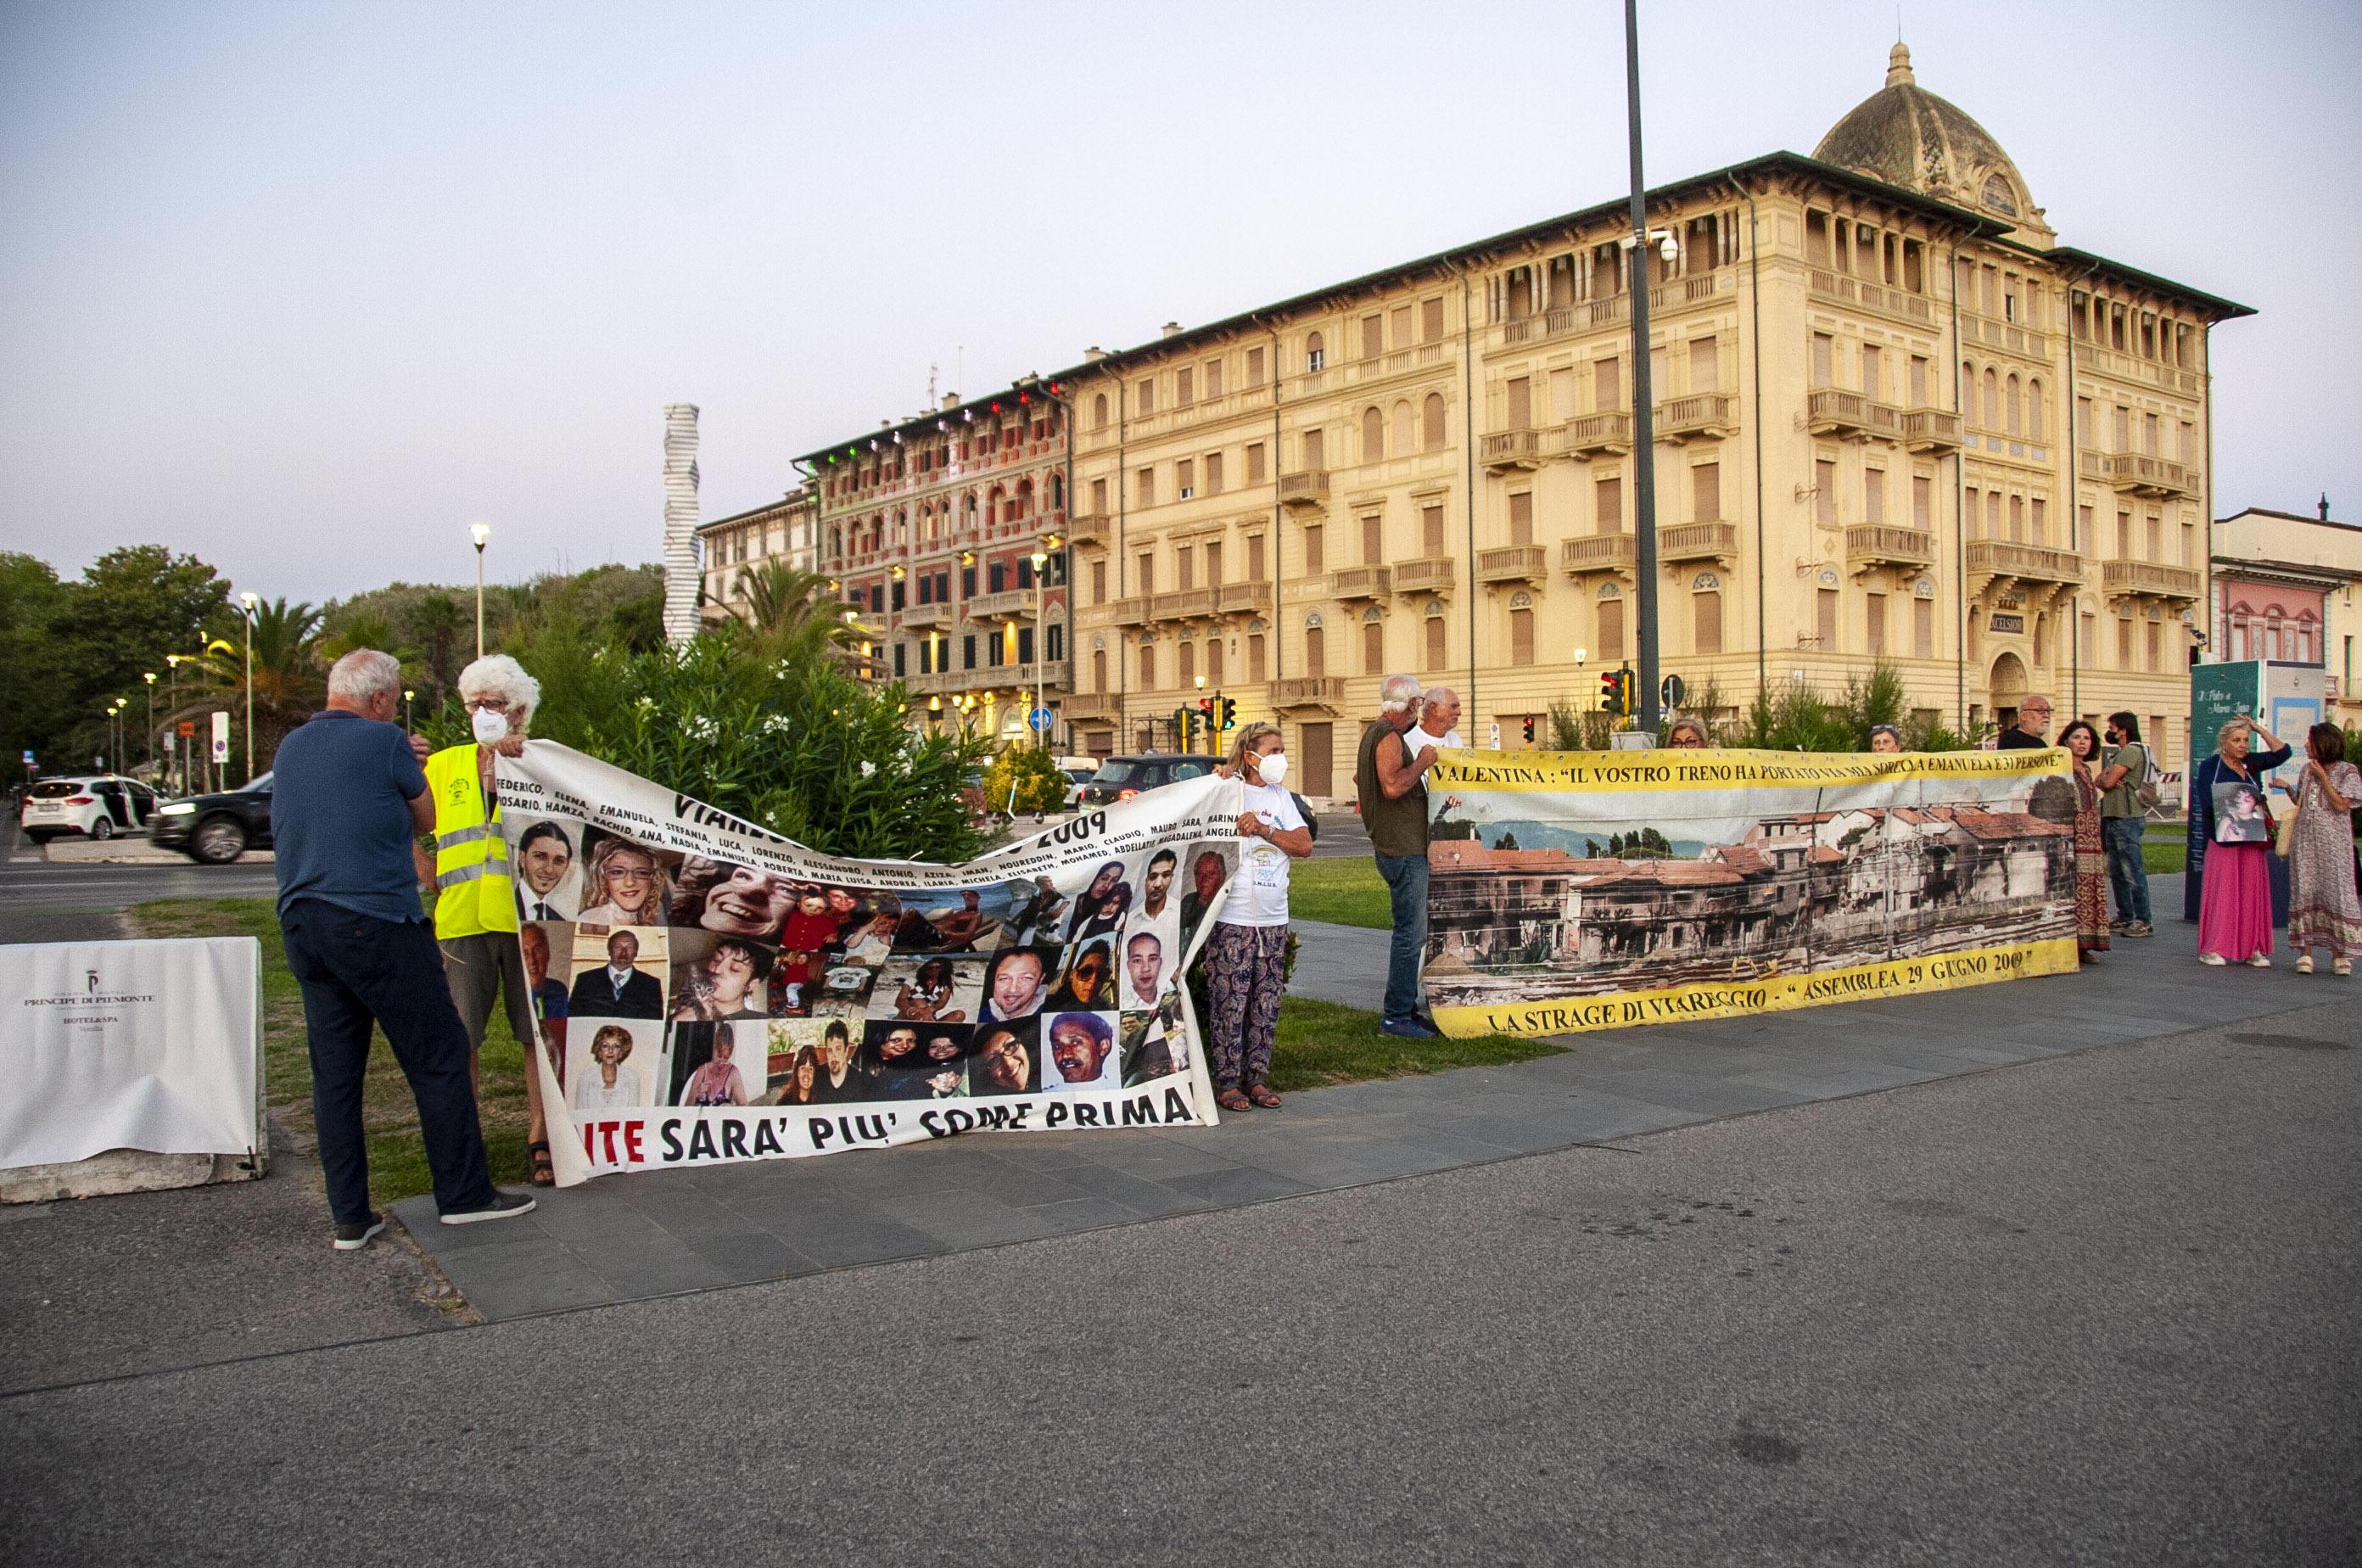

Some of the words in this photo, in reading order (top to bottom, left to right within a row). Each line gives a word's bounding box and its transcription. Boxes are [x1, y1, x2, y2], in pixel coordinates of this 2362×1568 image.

[1990, 617, 2023, 631] XCELSIOR
[1433, 764, 1546, 783] VALENTINA
[1593, 766, 1671, 783] VOSTRO
[1676, 764, 1732, 781] TRENO
[1736, 764, 1756, 780] HA
[1760, 765, 1820, 780] PORTATO
[1820, 767, 1847, 778] VIA
[1846, 766, 1872, 777] MIA
[1928, 758, 1993, 771] EMANUELA
[1995, 758, 2002, 770] E
[497, 778, 545, 796] FEDERICO,
[555, 791, 590, 810] ELENA,
[600, 805, 658, 827] EMANUELA,
[665, 822, 711, 844] STEFANIA,
[719, 837, 745, 853] LUCA,
[753, 846, 796, 865] LORENZO,
[803, 859, 865, 876] ALESSANDRO,
[871, 868, 917, 879] ANTONIO,
[924, 871, 955, 879] AZIZA,
[962, 866, 993, 876] IMAN,
[999, 853, 1057, 871] NOUREDDIN,
[1064, 843, 1098, 855] MARIO,
[1104, 830, 1144, 846] CLAUDIO,
[546, 802, 588, 820] HAMZA,
[593, 815, 635, 837] RACHID,
[639, 829, 665, 844] ANA,
[670, 837, 704, 854] NADIA,
[707, 848, 761, 867] EMANUELA,
[764, 862, 807, 879] ROBERTA,
[811, 871, 842, 882] MARIA
[846, 876, 876, 886] LUISA,
[880, 879, 921, 888] ANDREA,
[923, 879, 959, 888] ILARIA,
[961, 874, 1005, 884] MICHELA,
[1007, 863, 1059, 877] ELISABETH,
[1061, 850, 1111, 865] MOHAMED,
[24, 997, 79, 1006] PRINCIPE
[95, 994, 155, 1005] PIEMONTE
[1488, 1013, 1522, 1033] LA
[1526, 1003, 1616, 1032] STRAGE
[1622, 1000, 1644, 1022] DI
[1648, 988, 1766, 1017] VIAREGGIO
[1907, 965, 1923, 983] 29
[1931, 956, 1987, 980] GIUGNO
[661, 1117, 787, 1162] SARA'
[809, 1112, 896, 1150] PIU'
[920, 1103, 1033, 1138] COME
[1046, 1082, 1201, 1128] PRIMA
